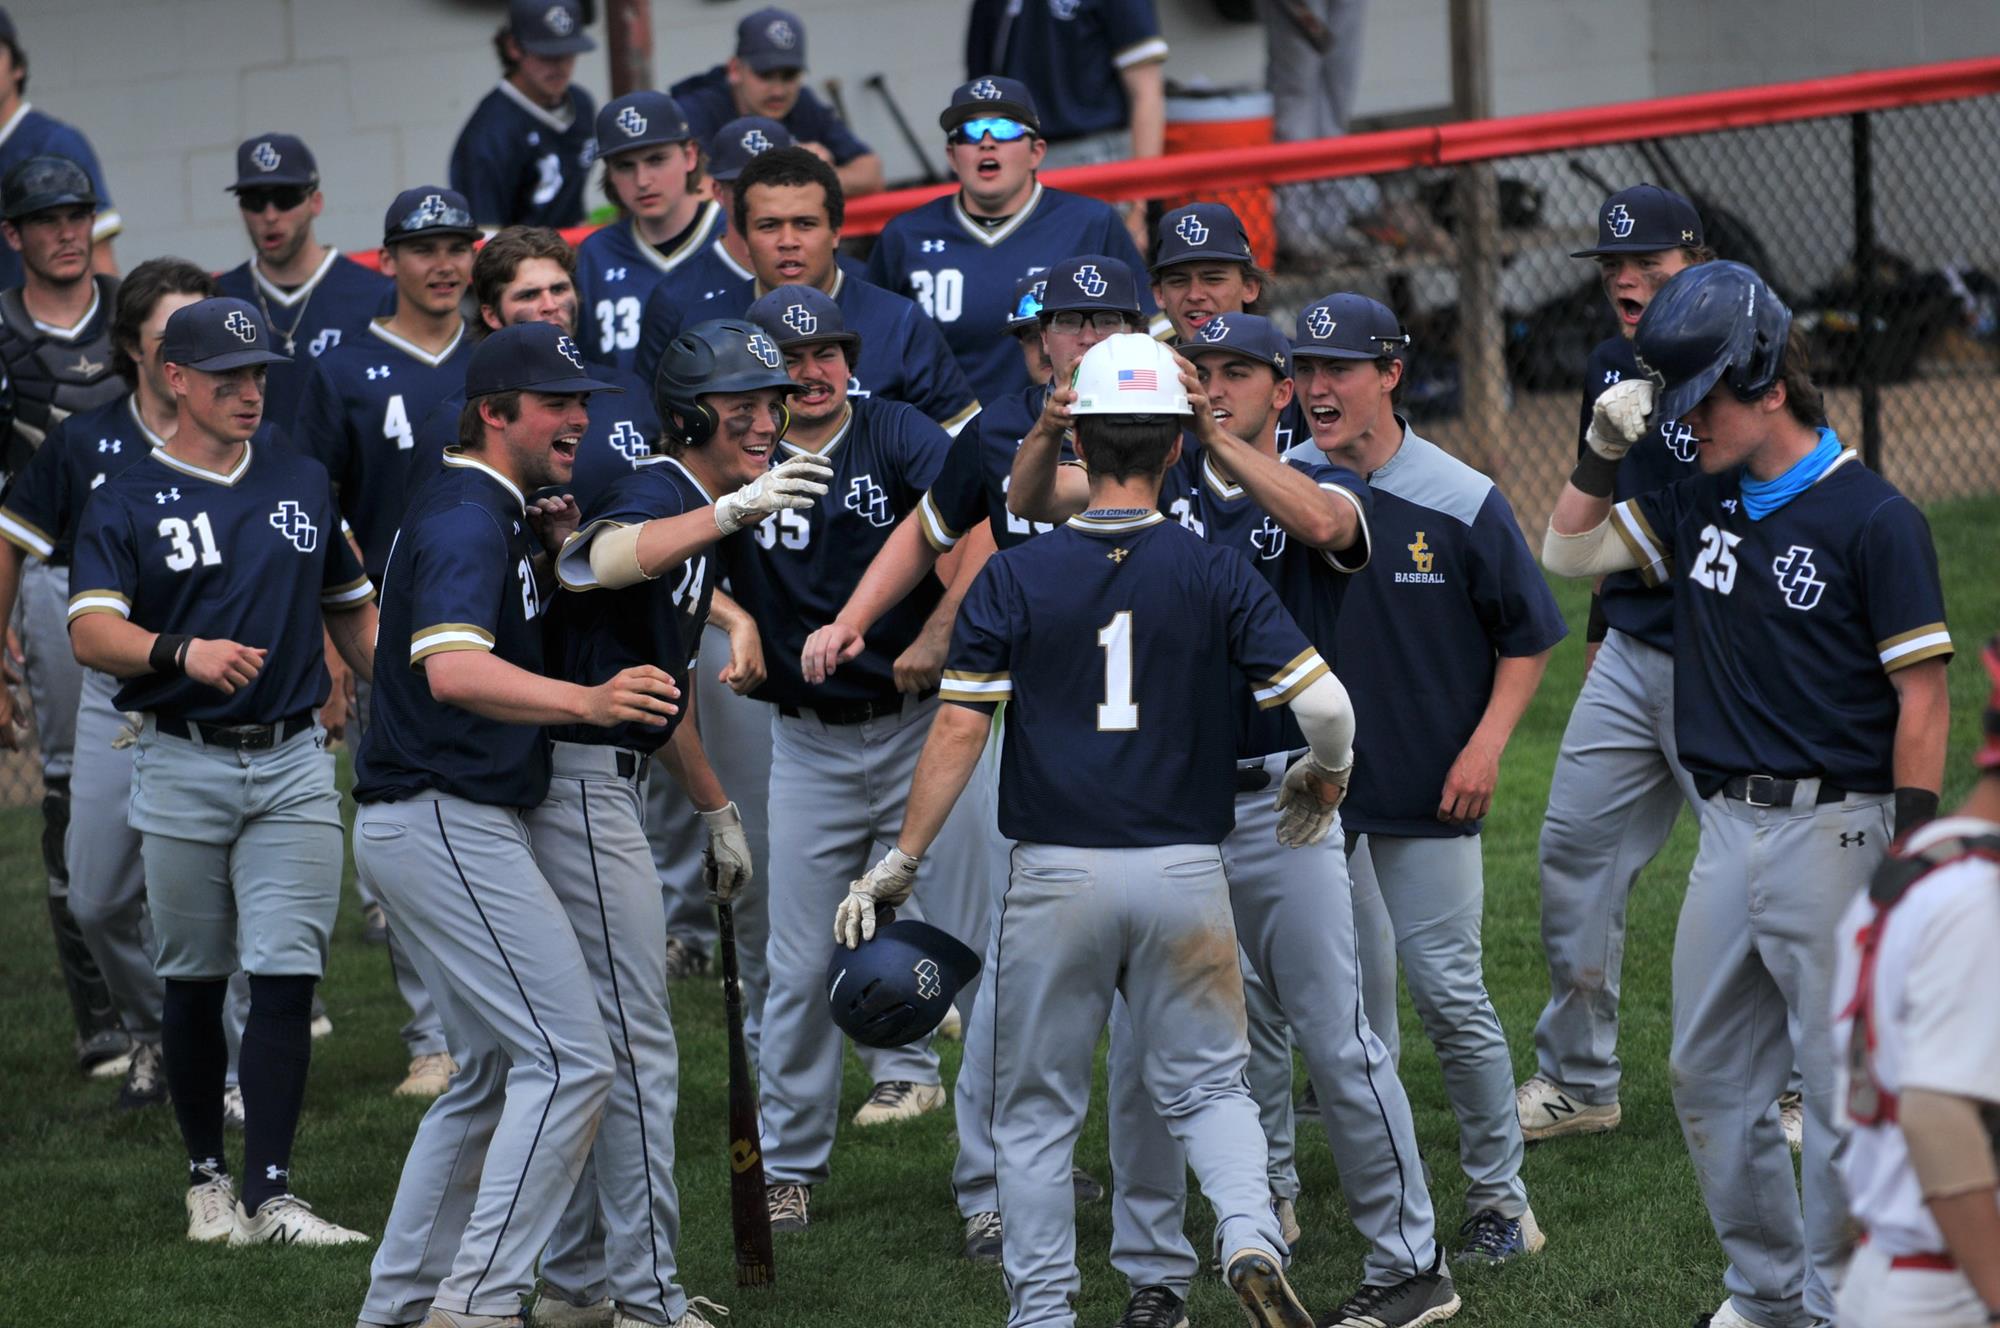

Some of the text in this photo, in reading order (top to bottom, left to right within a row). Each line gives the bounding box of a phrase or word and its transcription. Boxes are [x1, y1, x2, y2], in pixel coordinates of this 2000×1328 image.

[1176, 214, 1209, 246] JCU
[910, 269, 964, 322] 30
[1073, 265, 1108, 297] JCU
[225, 310, 256, 344] JCU
[596, 297, 641, 353] 33
[783, 304, 817, 335] JCU
[1306, 306, 1337, 339] JCU
[747, 334, 780, 369] JCU
[383, 395, 414, 450] 4
[158, 512, 222, 572] 31
[754, 507, 810, 550] 35
[1394, 572, 1446, 584] BASEBALL
[1690, 524, 1743, 595] 25
[1097, 610, 1140, 733] 1
